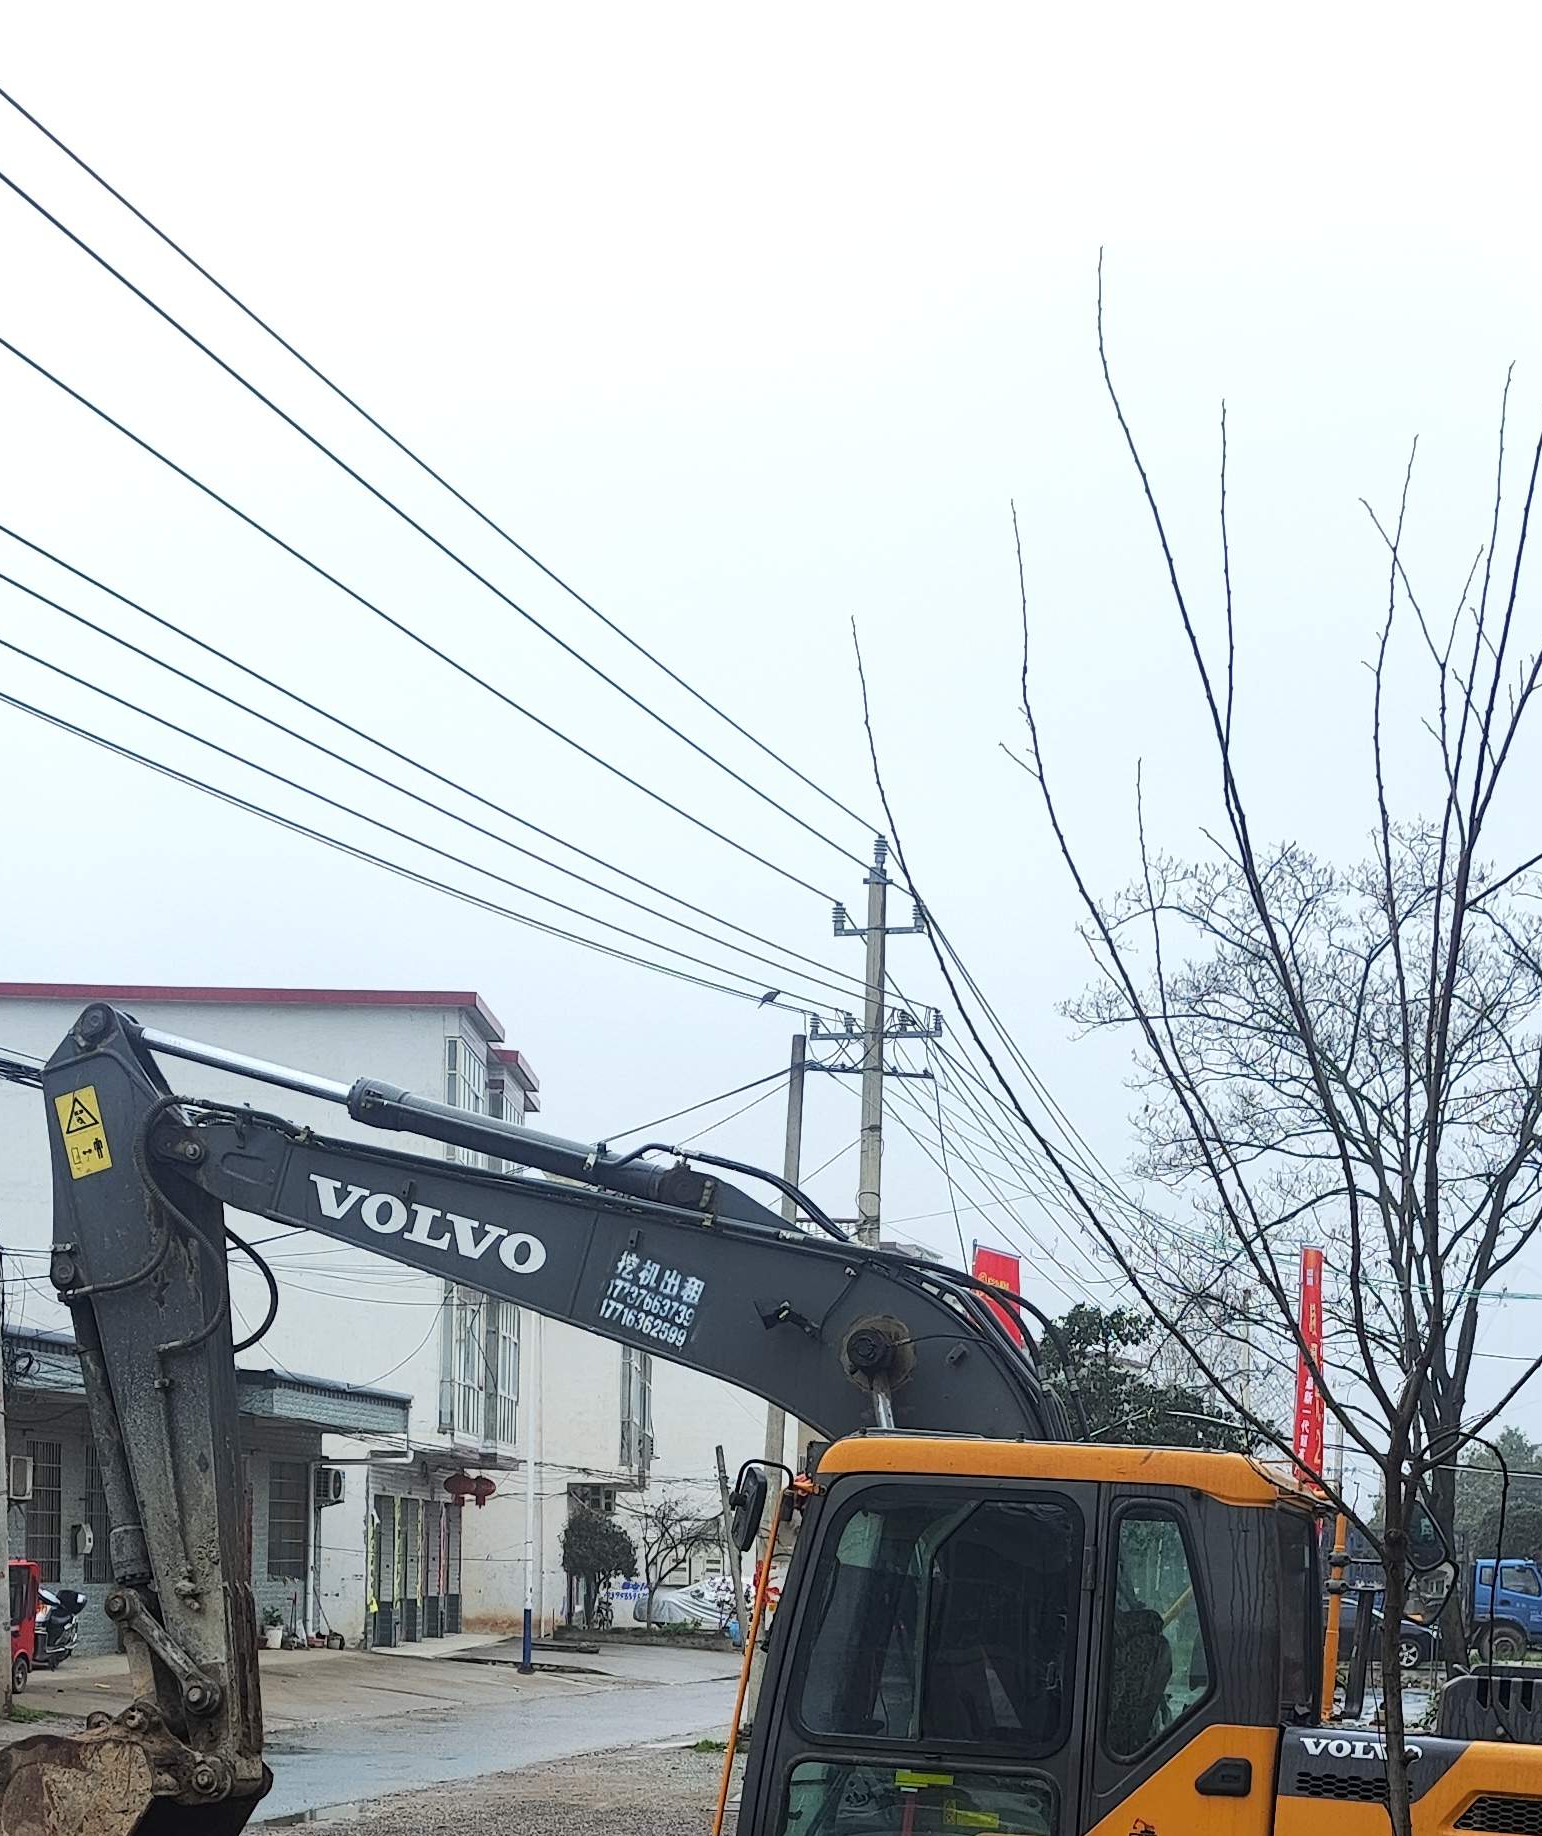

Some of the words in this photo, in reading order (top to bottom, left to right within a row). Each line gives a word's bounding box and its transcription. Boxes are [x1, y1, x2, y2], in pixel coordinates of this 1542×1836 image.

[309, 1173, 547, 1274] VOLVO
[606, 1279, 695, 1327] 17737663739
[615, 1251, 705, 1305] 挖机出租
[599, 1298, 687, 1347] 17716362599
